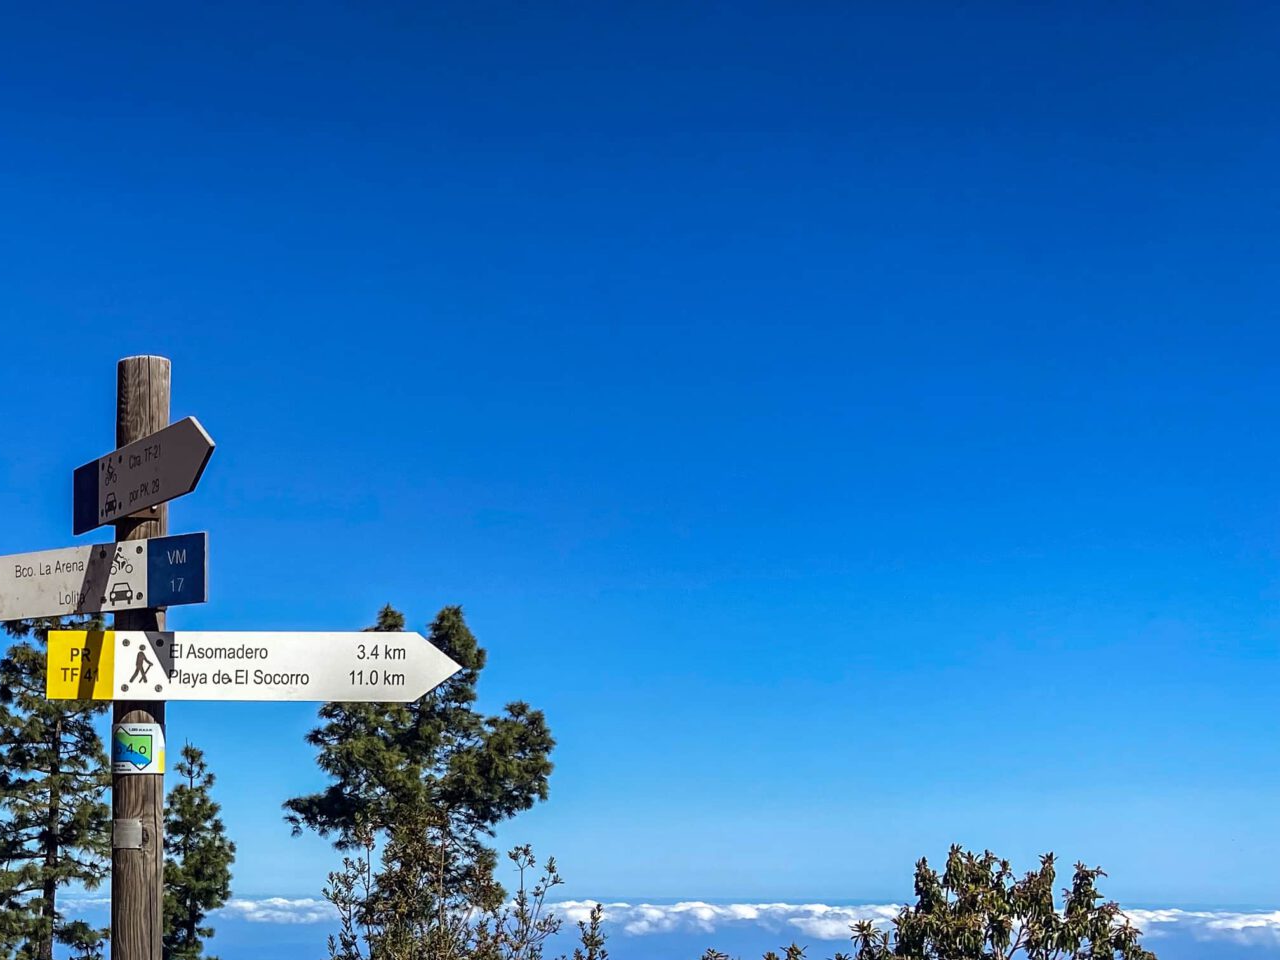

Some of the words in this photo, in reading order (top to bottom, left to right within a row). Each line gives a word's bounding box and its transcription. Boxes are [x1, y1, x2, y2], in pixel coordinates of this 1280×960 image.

[152, 478, 160, 494] 29
[167, 549, 187, 565] VM
[39, 562, 51, 576] La
[54, 560, 84, 573] Arena
[170, 578, 184, 592] 17
[70, 648, 91, 662] PR
[169, 644, 183, 659] El
[186, 643, 269, 660] Asomadero
[357, 644, 380, 660] 3.4
[384, 644, 406, 660] km
[61, 667, 79, 682] TF
[169, 669, 208, 688] Playa
[212, 669, 230, 685] de
[235, 669, 249, 685] El
[253, 669, 310, 685] Socorro
[349, 670, 379, 686] 11.0
[383, 670, 405, 686] km
